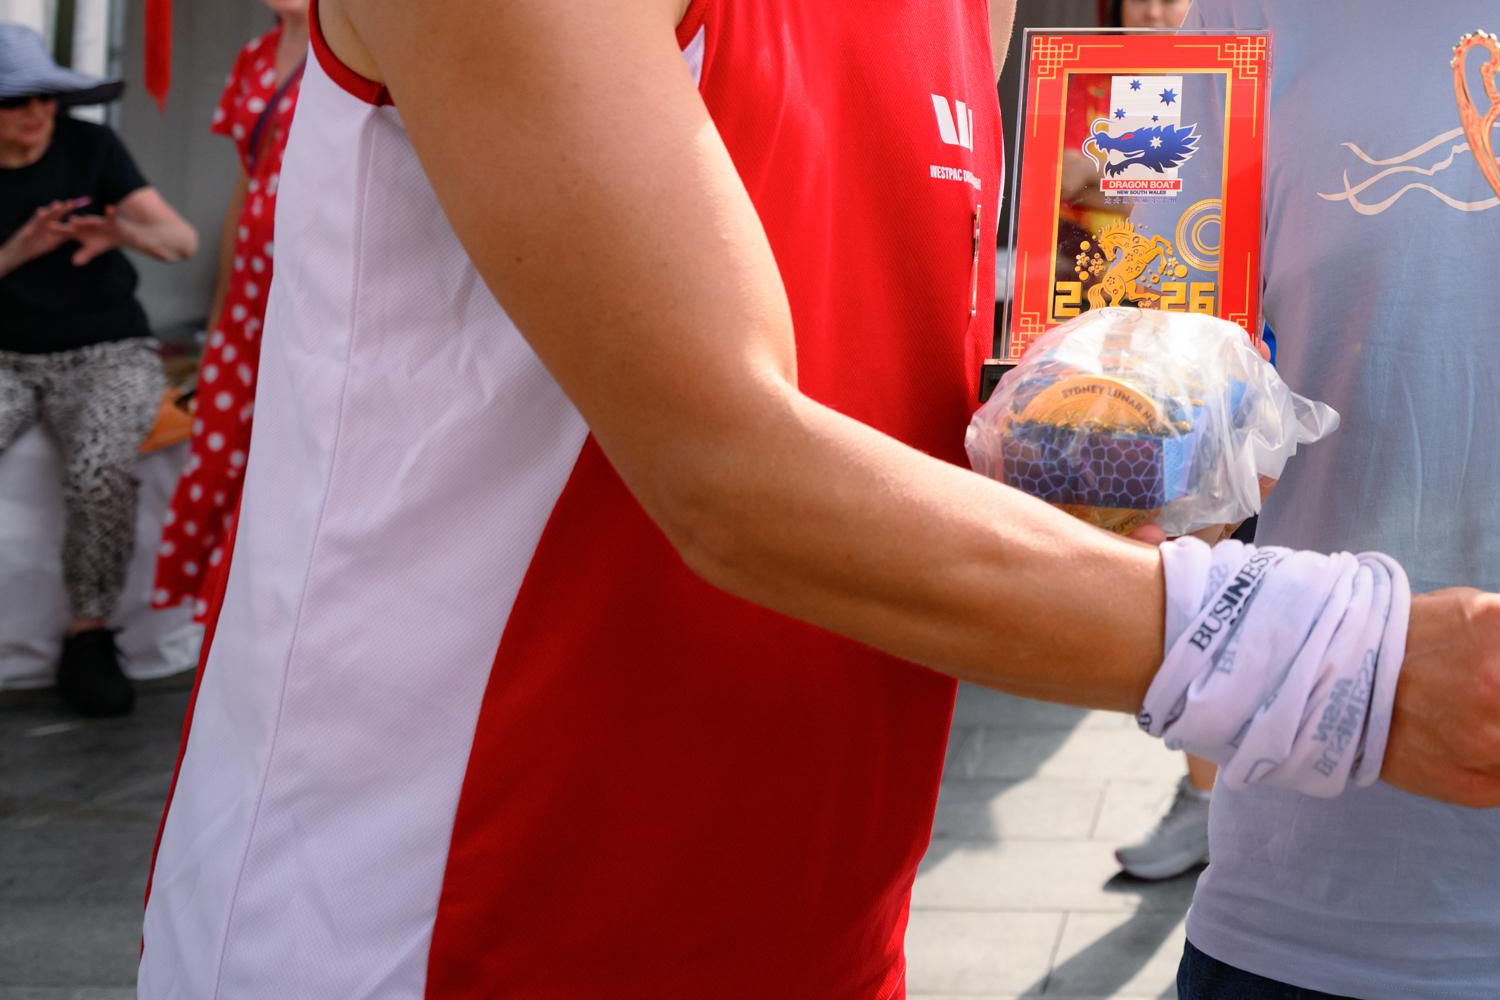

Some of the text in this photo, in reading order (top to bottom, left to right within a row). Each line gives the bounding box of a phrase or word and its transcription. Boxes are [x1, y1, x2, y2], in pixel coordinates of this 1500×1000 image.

[930, 165, 963, 181] WESTPAC
[1109, 180, 1176, 189] DRAGON BOAT
[1061, 385, 1142, 411] SYDNEY LUNAR
[1188, 551, 1277, 653] BUSINESS
